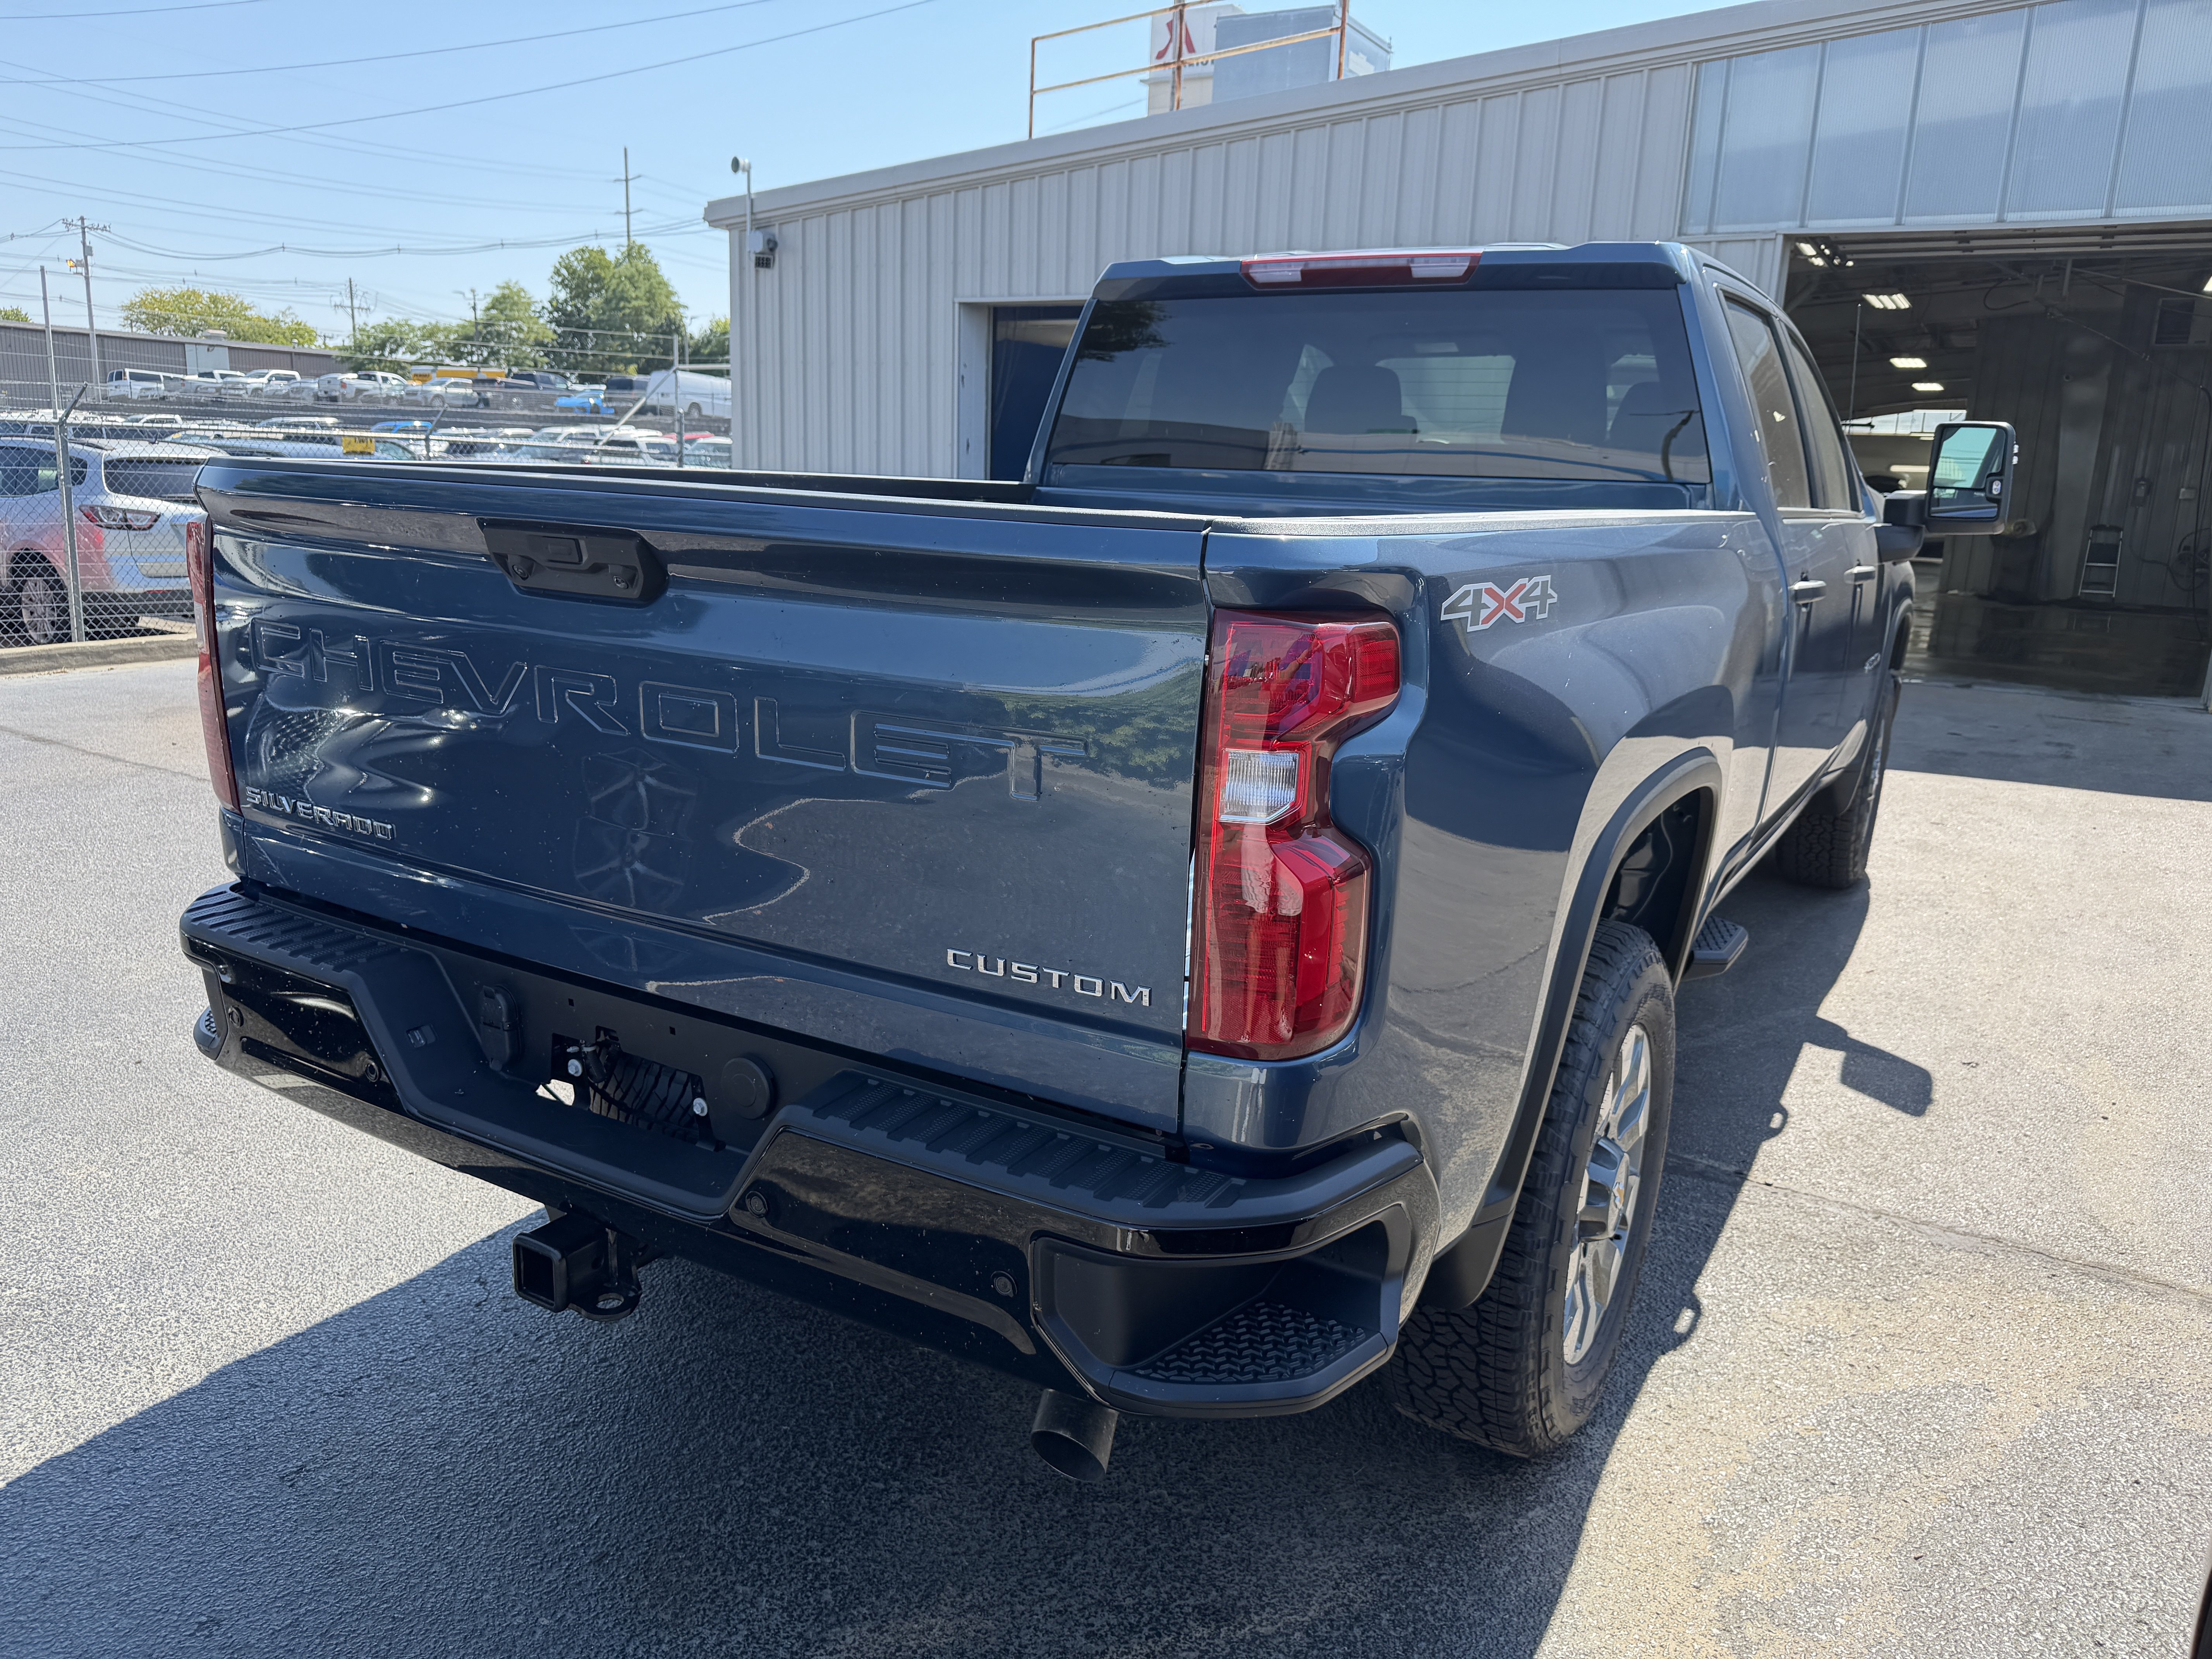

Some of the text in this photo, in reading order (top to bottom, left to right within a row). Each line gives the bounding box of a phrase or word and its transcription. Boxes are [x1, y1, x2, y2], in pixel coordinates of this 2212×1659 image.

[250, 617, 1085, 801] CHEVROLET
[246, 785, 396, 841] SILVERADO
[947, 948, 1152, 1006] CUSTOM
